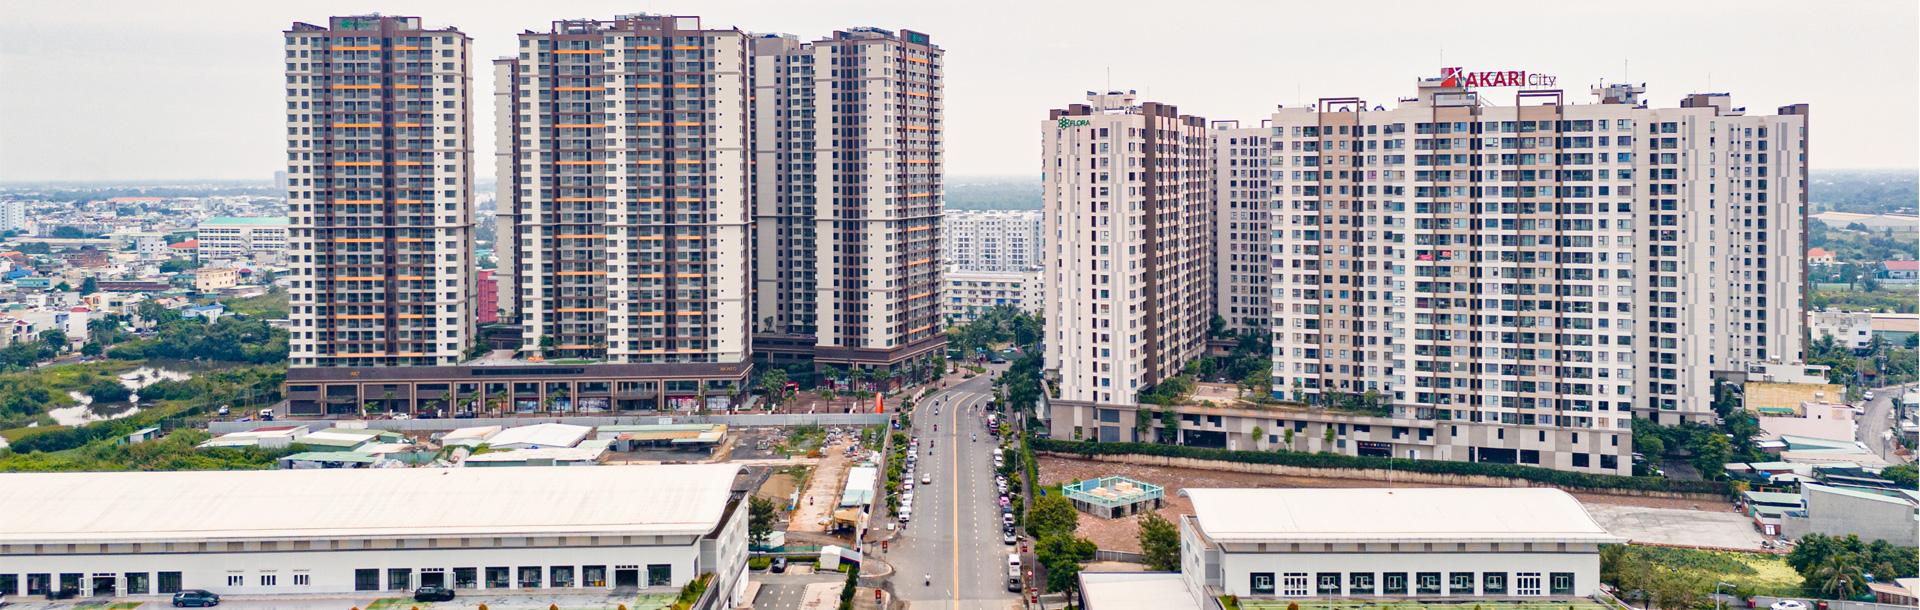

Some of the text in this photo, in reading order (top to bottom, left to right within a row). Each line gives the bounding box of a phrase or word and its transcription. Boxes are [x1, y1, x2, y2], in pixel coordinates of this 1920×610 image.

[1465, 70, 1557, 87] AKARI City
[1069, 119, 1090, 127] FLORA
